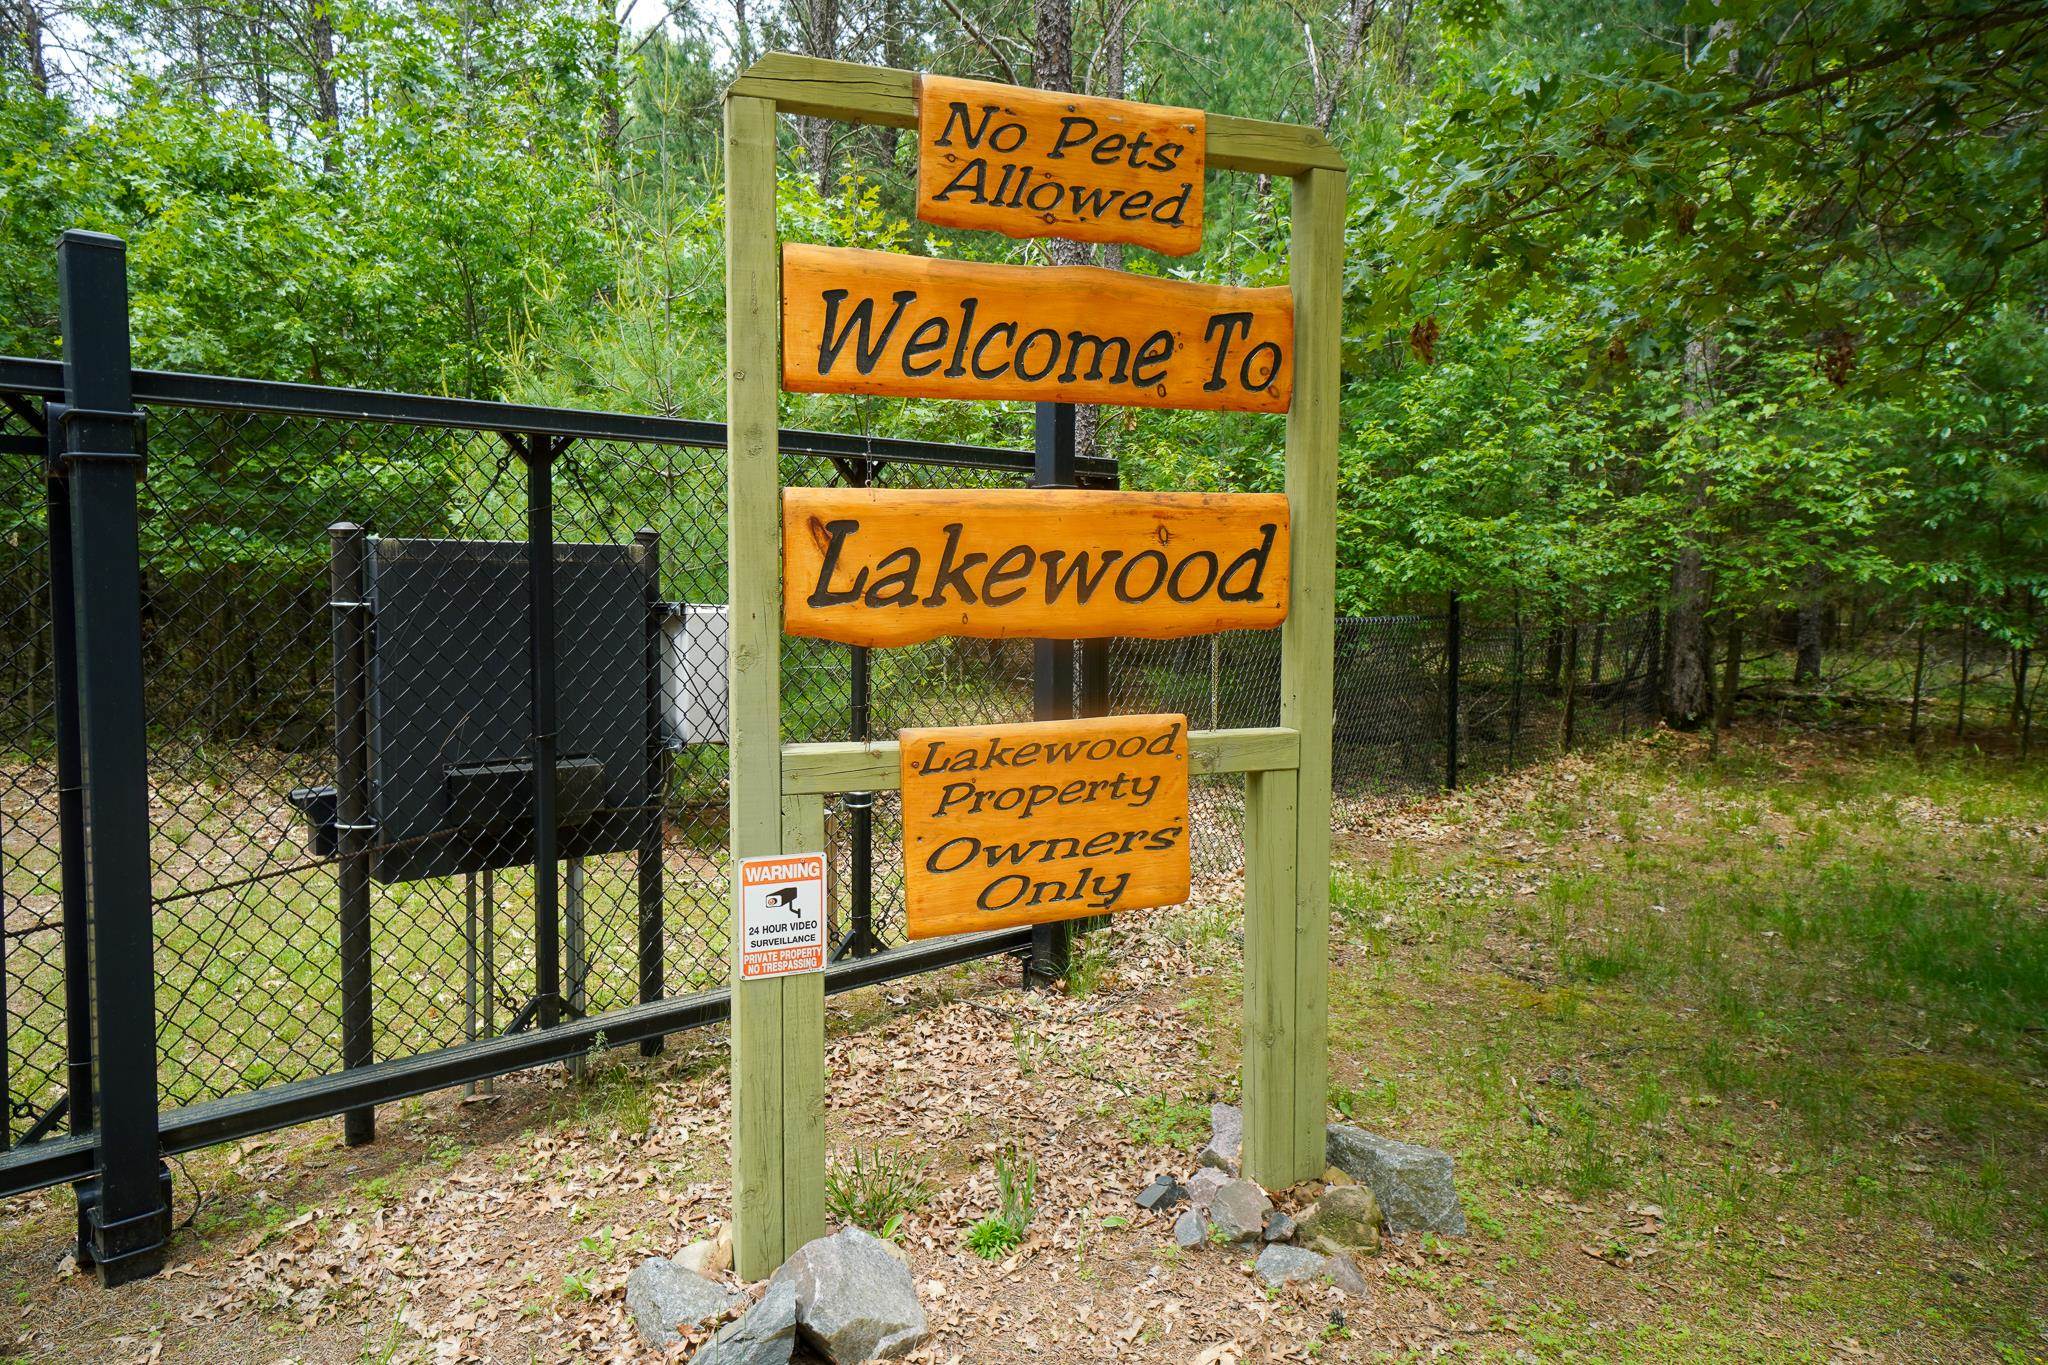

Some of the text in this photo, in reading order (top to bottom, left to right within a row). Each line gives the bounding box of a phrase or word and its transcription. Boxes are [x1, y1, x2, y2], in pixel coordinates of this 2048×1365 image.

[934, 102, 1184, 172] No Pets
[932, 158, 1193, 227] Allowed
[818, 288, 1283, 392] Welcome To
[806, 519, 1277, 608] Lakewood
[918, 723, 1181, 776] Lakewood
[931, 772, 1161, 819] Property
[745, 862, 820, 882] WARNING
[926, 825, 1182, 874] Owners
[976, 867, 1131, 911] Only
[749, 920, 817, 936] 24 HOUR VIDEO
[750, 934, 816, 948] SURVEILLANCE
[744, 946, 822, 964] PRIVATE PROPERTY
[748, 964, 759, 974] NO
[762, 958, 817, 973] TRESPASSING
